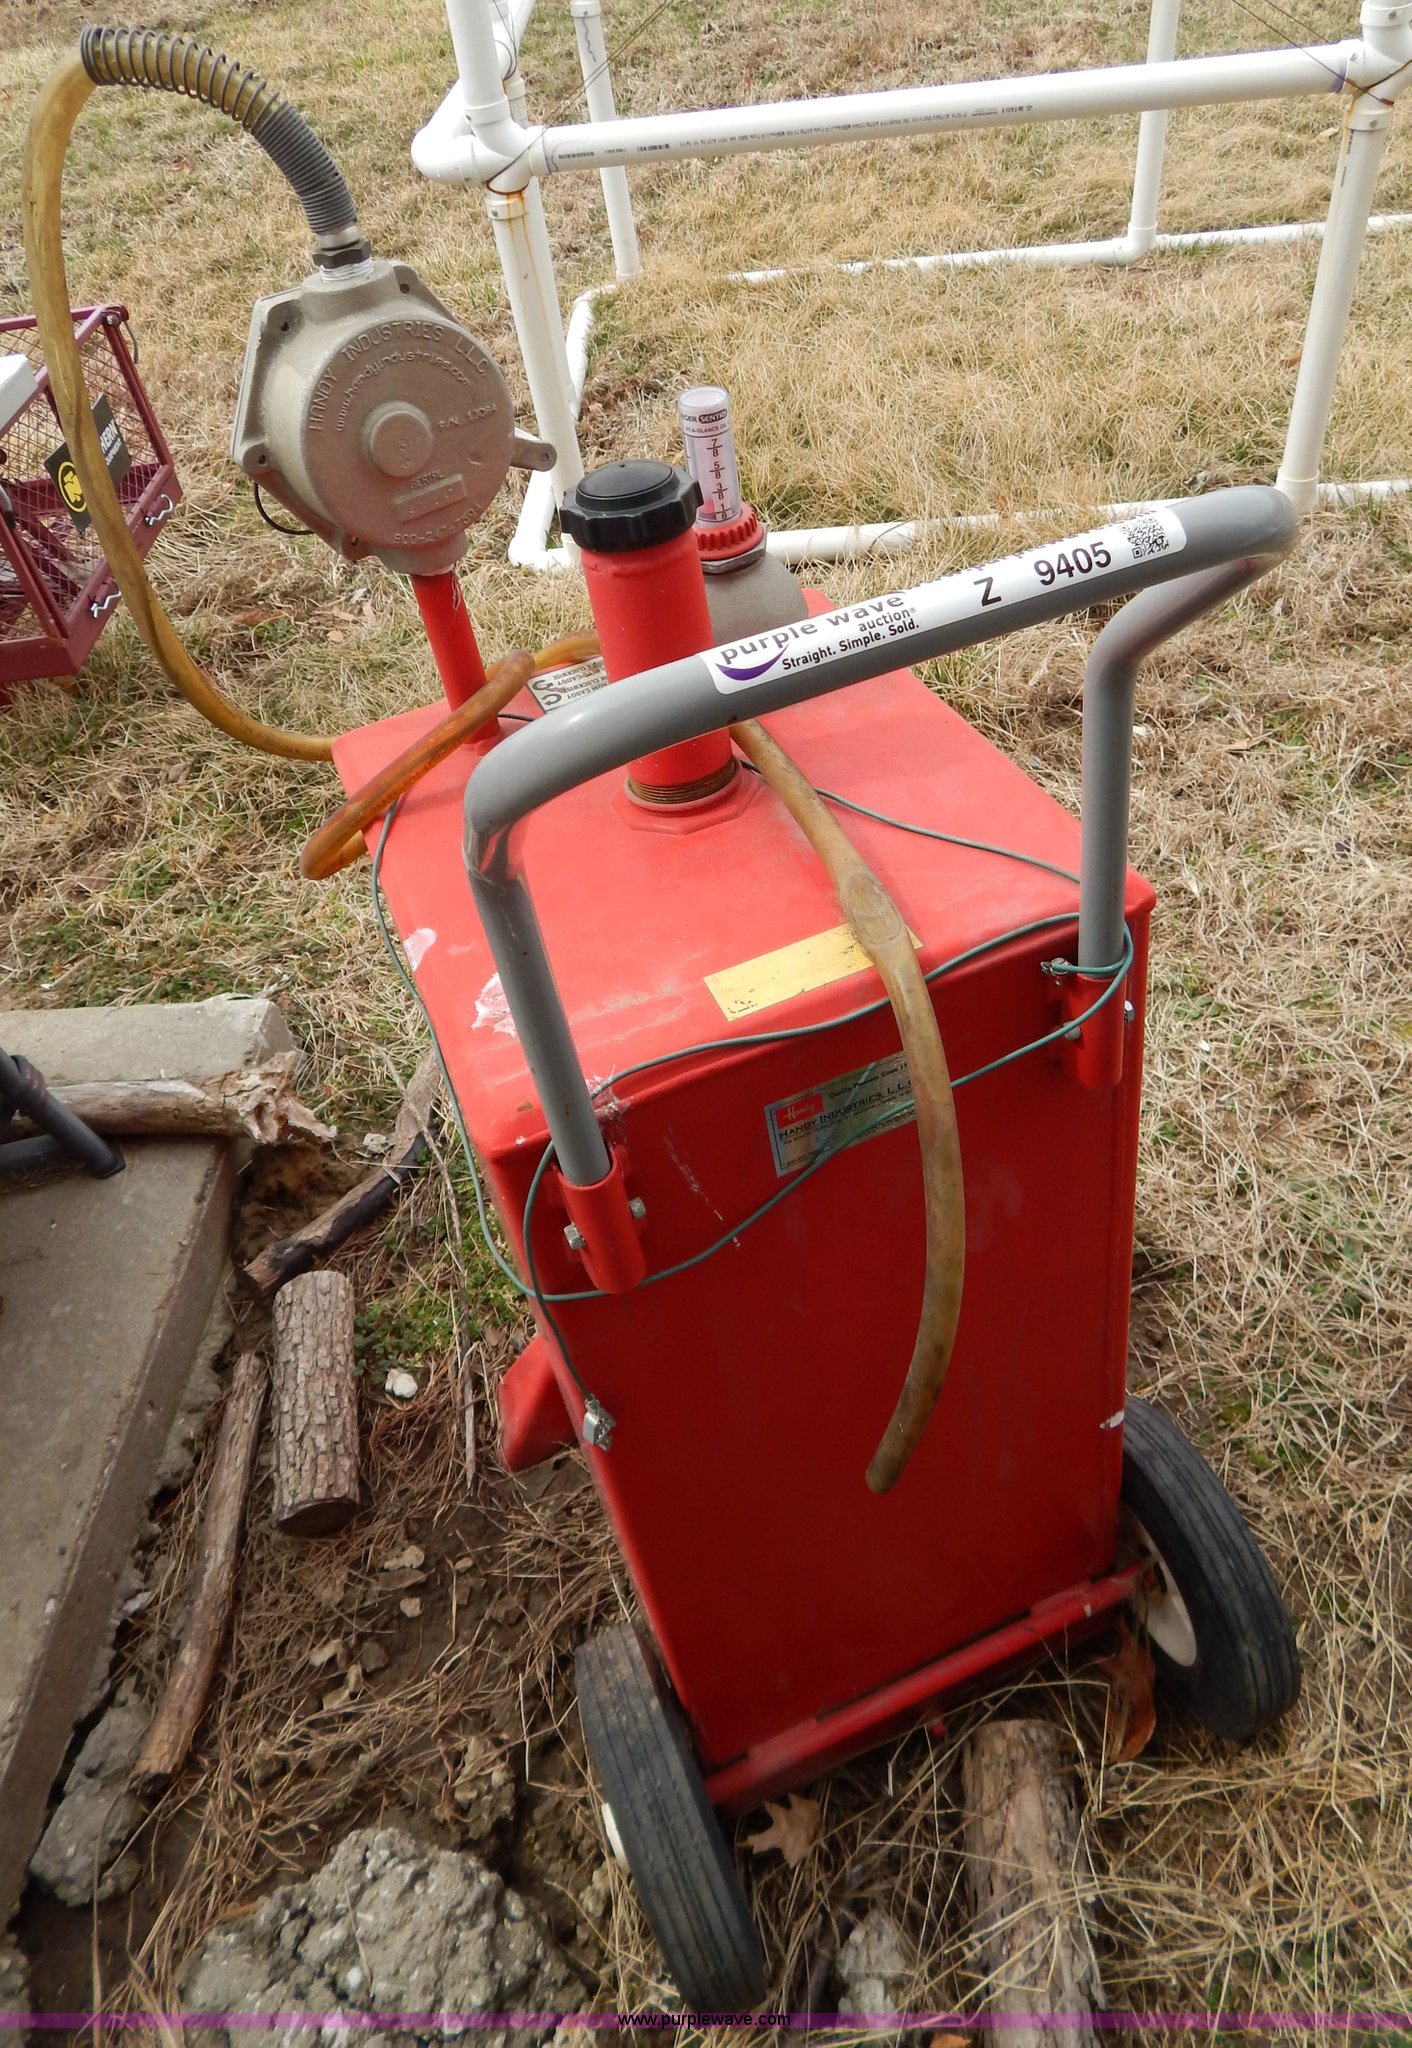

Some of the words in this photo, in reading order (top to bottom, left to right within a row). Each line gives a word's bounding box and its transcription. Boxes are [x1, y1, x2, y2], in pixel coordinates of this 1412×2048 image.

[308, 367, 338, 432] HANDY
[340, 320, 444, 362] INDUSTRIES
[453, 336, 490, 378] LLC
[973, 576, 1002, 607] Z
[1033, 541, 1112, 586] 9405
[720, 621, 818, 665] purple
[826, 594, 904, 627] wave
[782, 646, 836, 671] Straight.
[839, 631, 886, 653] Simple.
[888, 618, 920, 637] Sold.
[778, 1116, 818, 1141] HANDY
